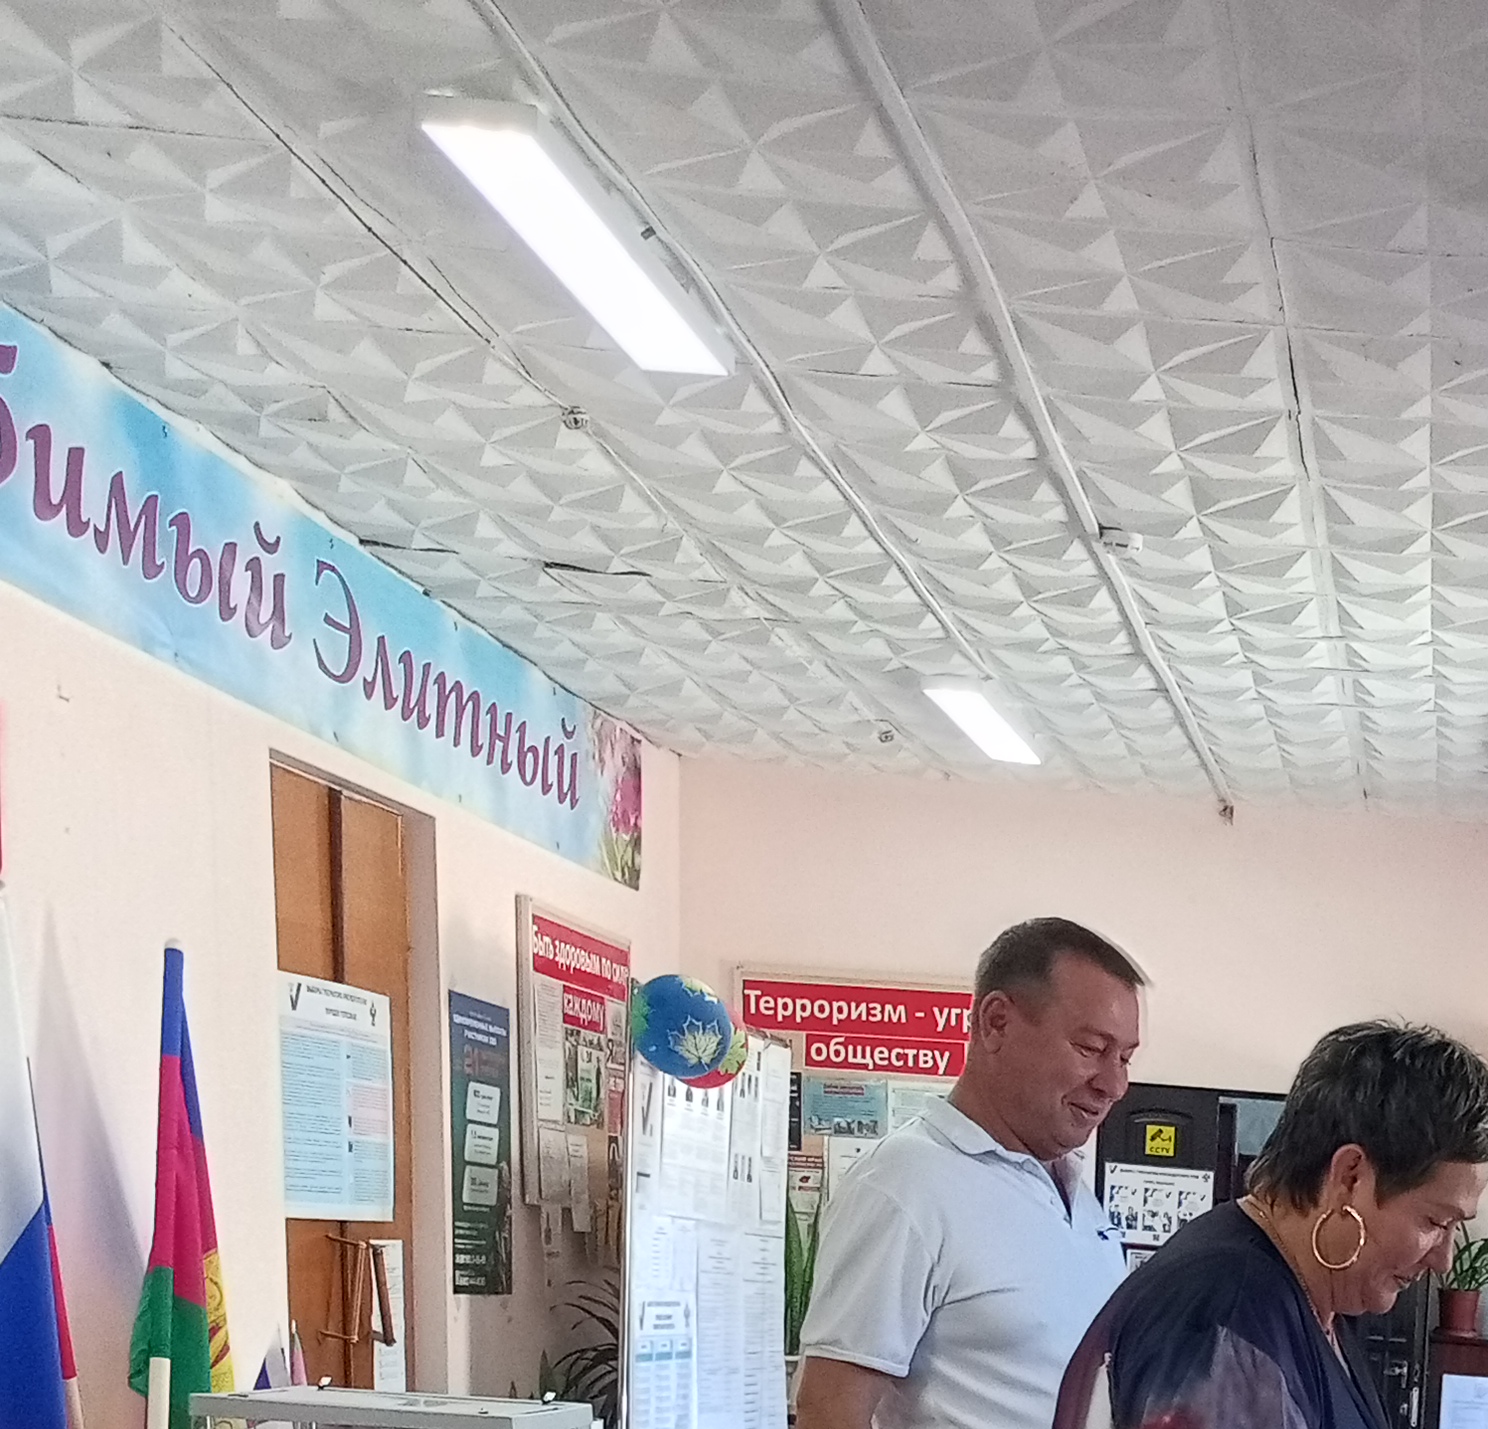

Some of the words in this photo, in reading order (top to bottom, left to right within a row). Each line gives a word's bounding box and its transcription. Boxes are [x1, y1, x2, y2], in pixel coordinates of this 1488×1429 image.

[313, 558, 580, 811] Элитный
[554, 939, 601, 976] здоровым
[563, 992, 605, 1032] каждому
[744, 989, 907, 1025] Терроризм
[810, 1036, 951, 1075] обществу
[1149, 1146, 1171, 1154] CCTV
